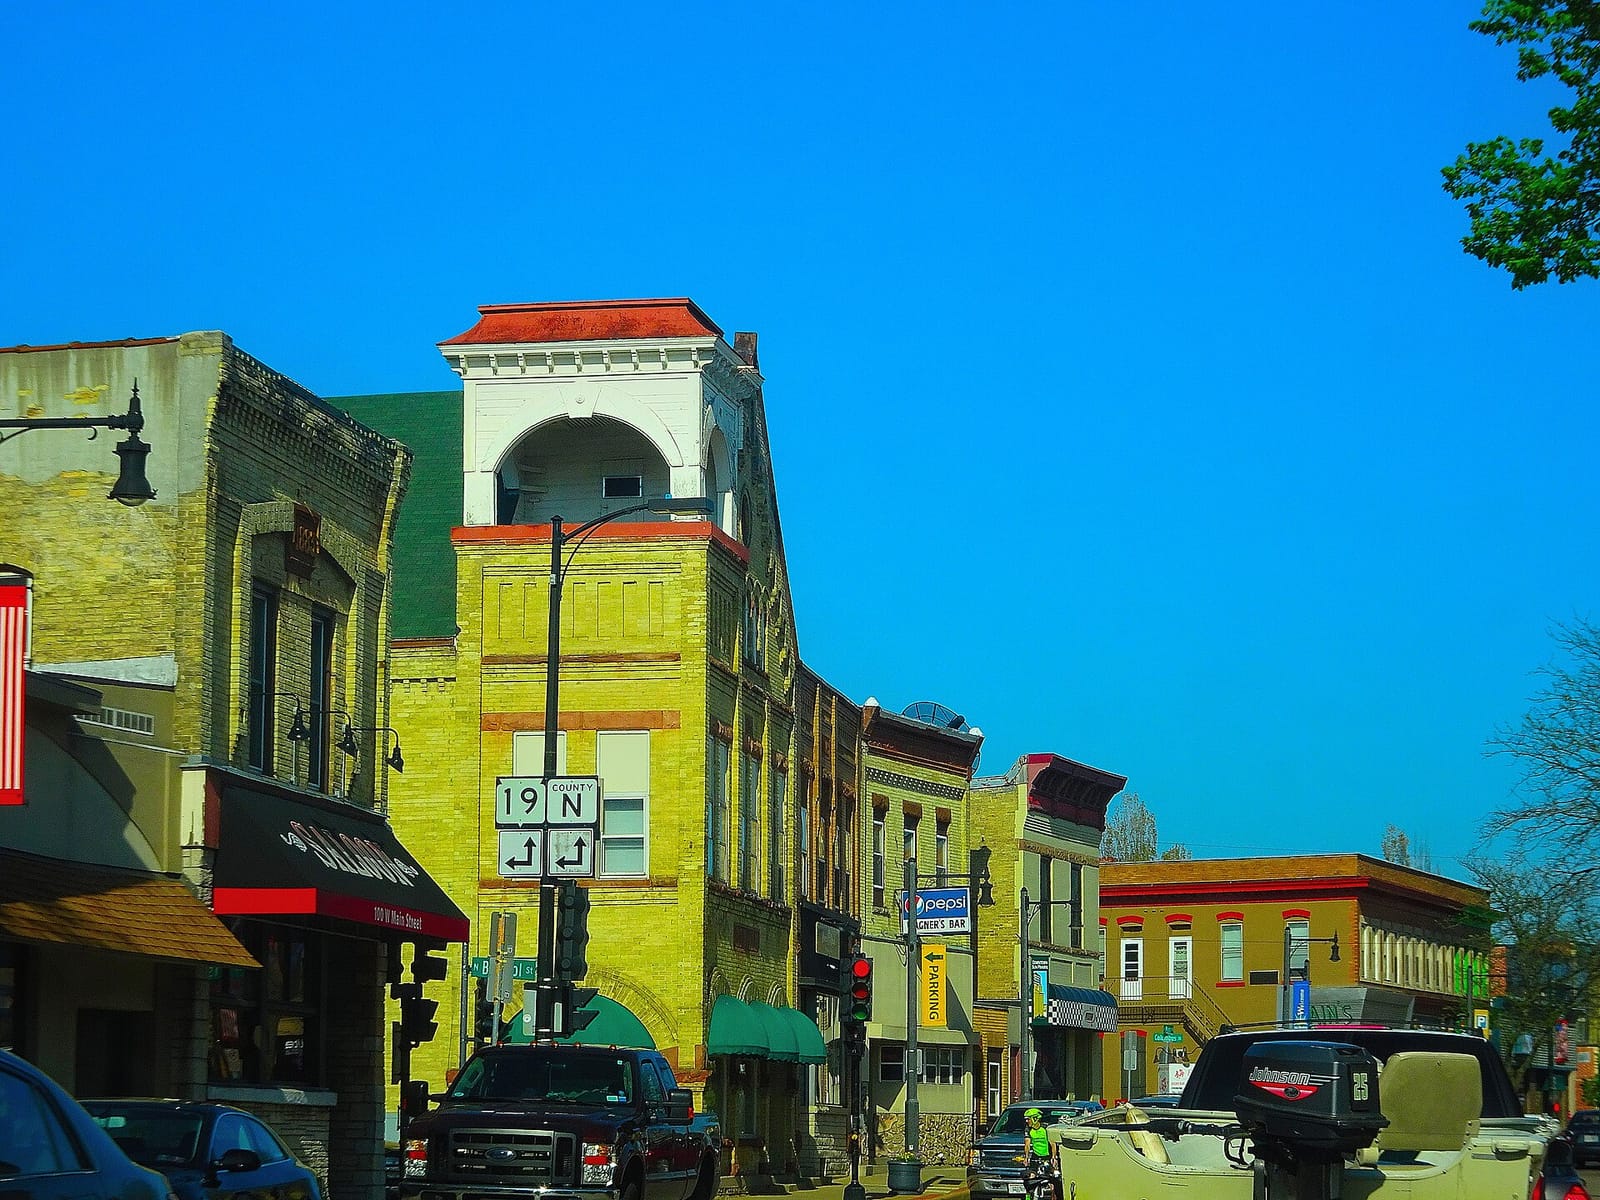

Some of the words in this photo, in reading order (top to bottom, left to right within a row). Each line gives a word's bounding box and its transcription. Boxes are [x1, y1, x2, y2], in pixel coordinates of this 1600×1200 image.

[552, 784, 593, 792] COUNTY
[504, 788, 538, 815] 19
[562, 793, 581, 817] N
[290, 820, 415, 887] SALOON
[925, 895, 966, 912] pepsi
[374, 907, 384, 921] 100
[385, 908, 390, 923] W
[391, 910, 405, 926] Main
[406, 913, 422, 930] Street
[950, 919, 966, 929] BAR
[473, 963, 479, 971] N
[526, 966, 533, 974] St
[929, 965, 939, 1020] PARKING
[1477, 1016, 1485, 1027] P
[1248, 1066, 1311, 1086] Johnson
[1353, 1072, 1369, 1101] 25
